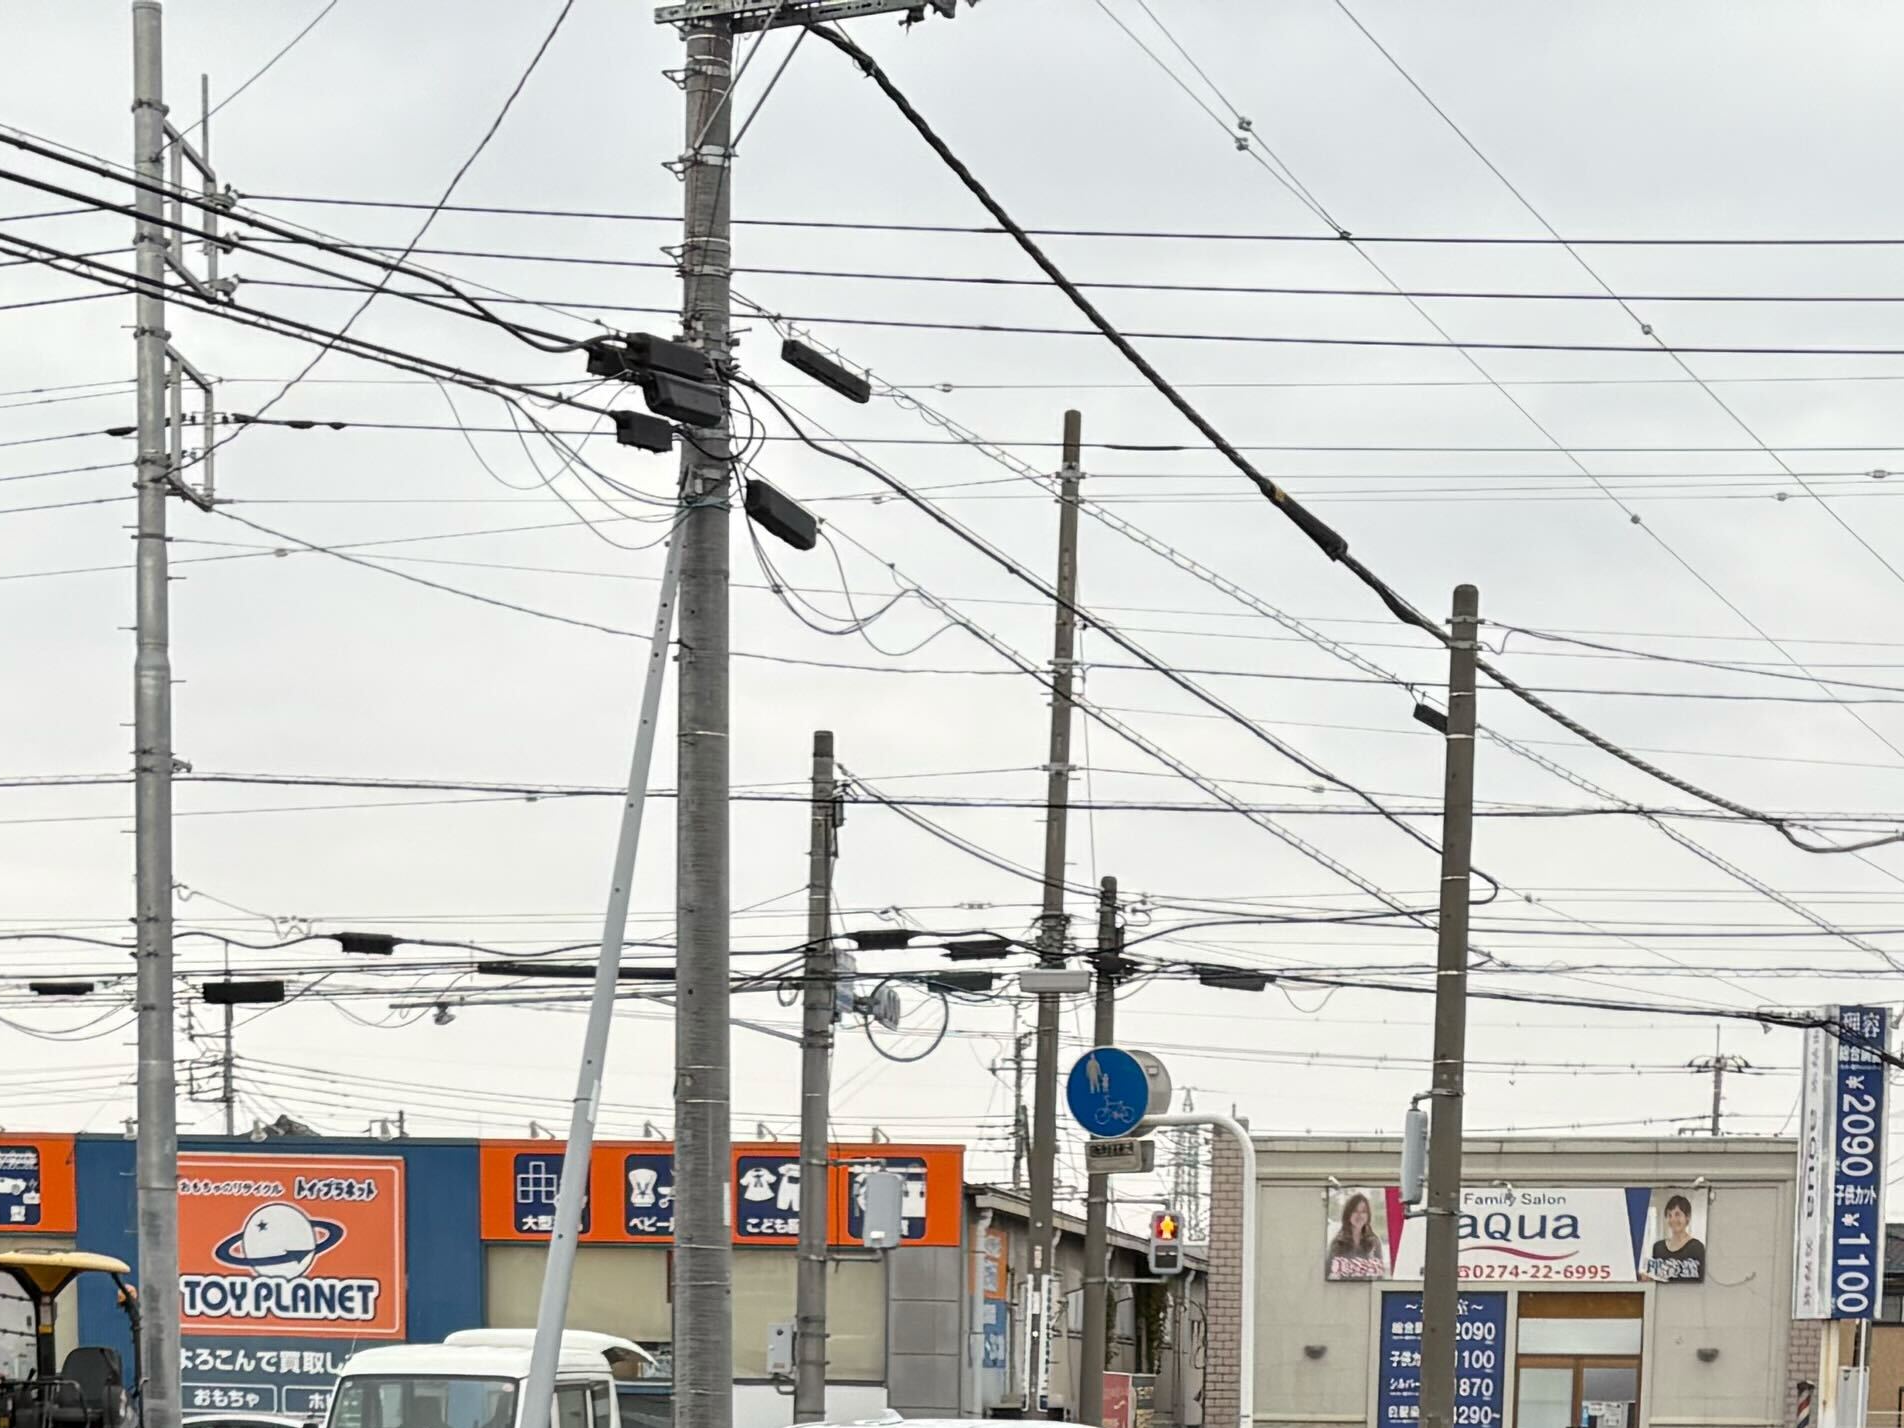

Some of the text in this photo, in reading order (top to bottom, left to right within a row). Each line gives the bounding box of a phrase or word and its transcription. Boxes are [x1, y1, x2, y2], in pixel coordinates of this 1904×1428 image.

[1840, 1094, 1877, 1177] 2090
[179, 1180, 284, 1196] おもちゃのリサイクル
[1464, 1192, 1567, 1206] Family Salon
[1472, 1264, 1612, 1281] 0274-22-6995
[1836, 1233, 1871, 1313] 1100
[182, 1279, 376, 1316] TOY PLANET
[180, 1348, 352, 1375] よろこんで買取し
[194, 1389, 260, 1408] おもちゃ
